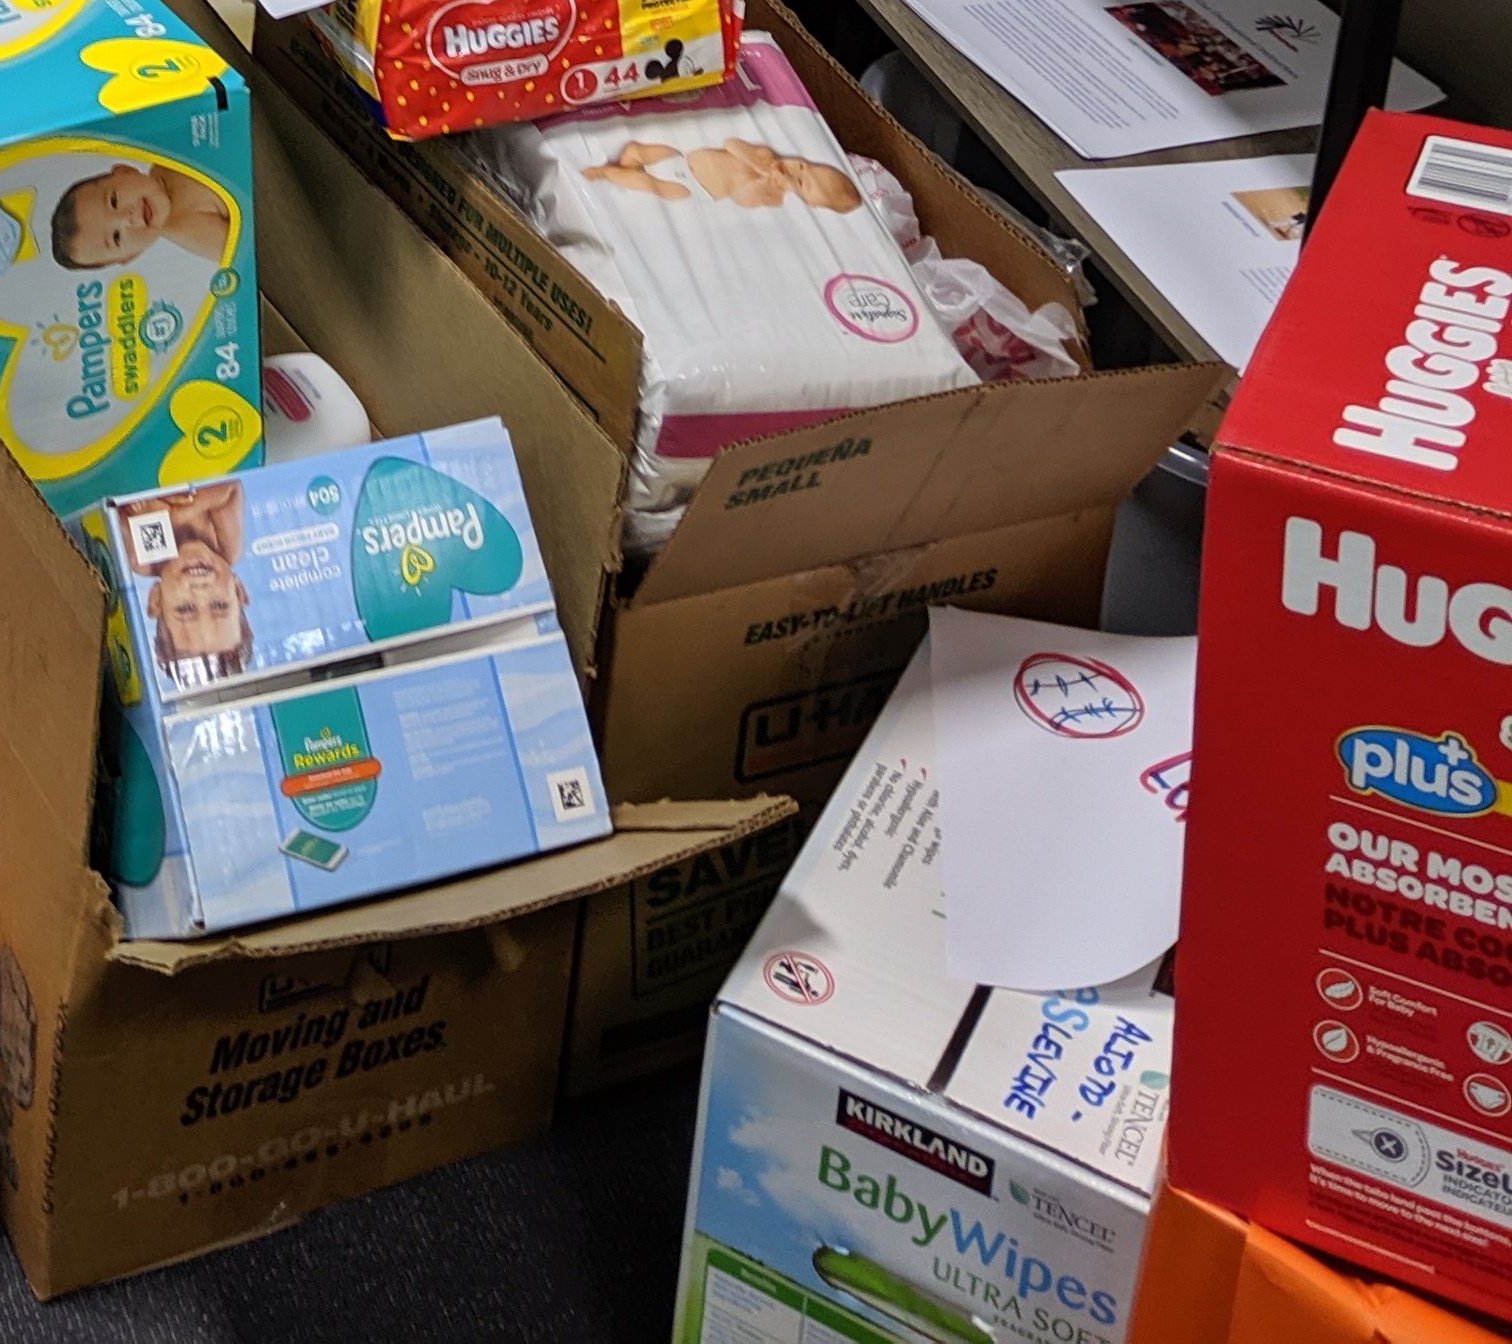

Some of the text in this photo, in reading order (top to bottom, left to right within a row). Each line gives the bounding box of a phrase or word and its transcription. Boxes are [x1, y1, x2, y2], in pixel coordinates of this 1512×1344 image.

[120, 12, 168, 40] 84
[444, 17, 560, 58] HUGGIES
[135, 57, 176, 81] 2
[603, 62, 639, 87] 44
[458, 195, 594, 335] FOR MULTIPLE USES!
[485, 256, 554, 333] 10-12 Years
[846, 288, 890, 311] Care
[65, 278, 105, 423] Pampers
[122, 277, 139, 395] swaddlers
[215, 339, 240, 382] 84
[1333, 253, 1512, 471] HUGGIES
[196, 420, 228, 450] 2
[736, 434, 876, 489] PEQUEÑA
[309, 484, 341, 507] 504
[724, 469, 825, 511] SMALL
[361, 503, 485, 557] Pampers
[268, 565, 343, 593] complete
[270, 547, 332, 571] clean
[896, 568, 999, 609] HANDLES
[293, 743, 361, 770] Rewards
[1353, 740, 1485, 804] plus
[646, 821, 790, 907] SAVE
[1327, 821, 1421, 875] OUR
[1323, 908, 1410, 959] PLUS
[1324, 882, 1447, 943] NOTRE
[208, 975, 431, 1078] Moving and
[178, 1015, 448, 1128] Storage Boxes
[1004, 1021, 1073, 1120] LEVINE
[844, 1096, 990, 1179] KIRKLAND
[1113, 1088, 1161, 1168] TENCEL
[817, 1143, 1119, 1328] BabyWipes
[1030, 1195, 1117, 1245] TENCEL
[932, 1257, 1023, 1321] ULTRA
